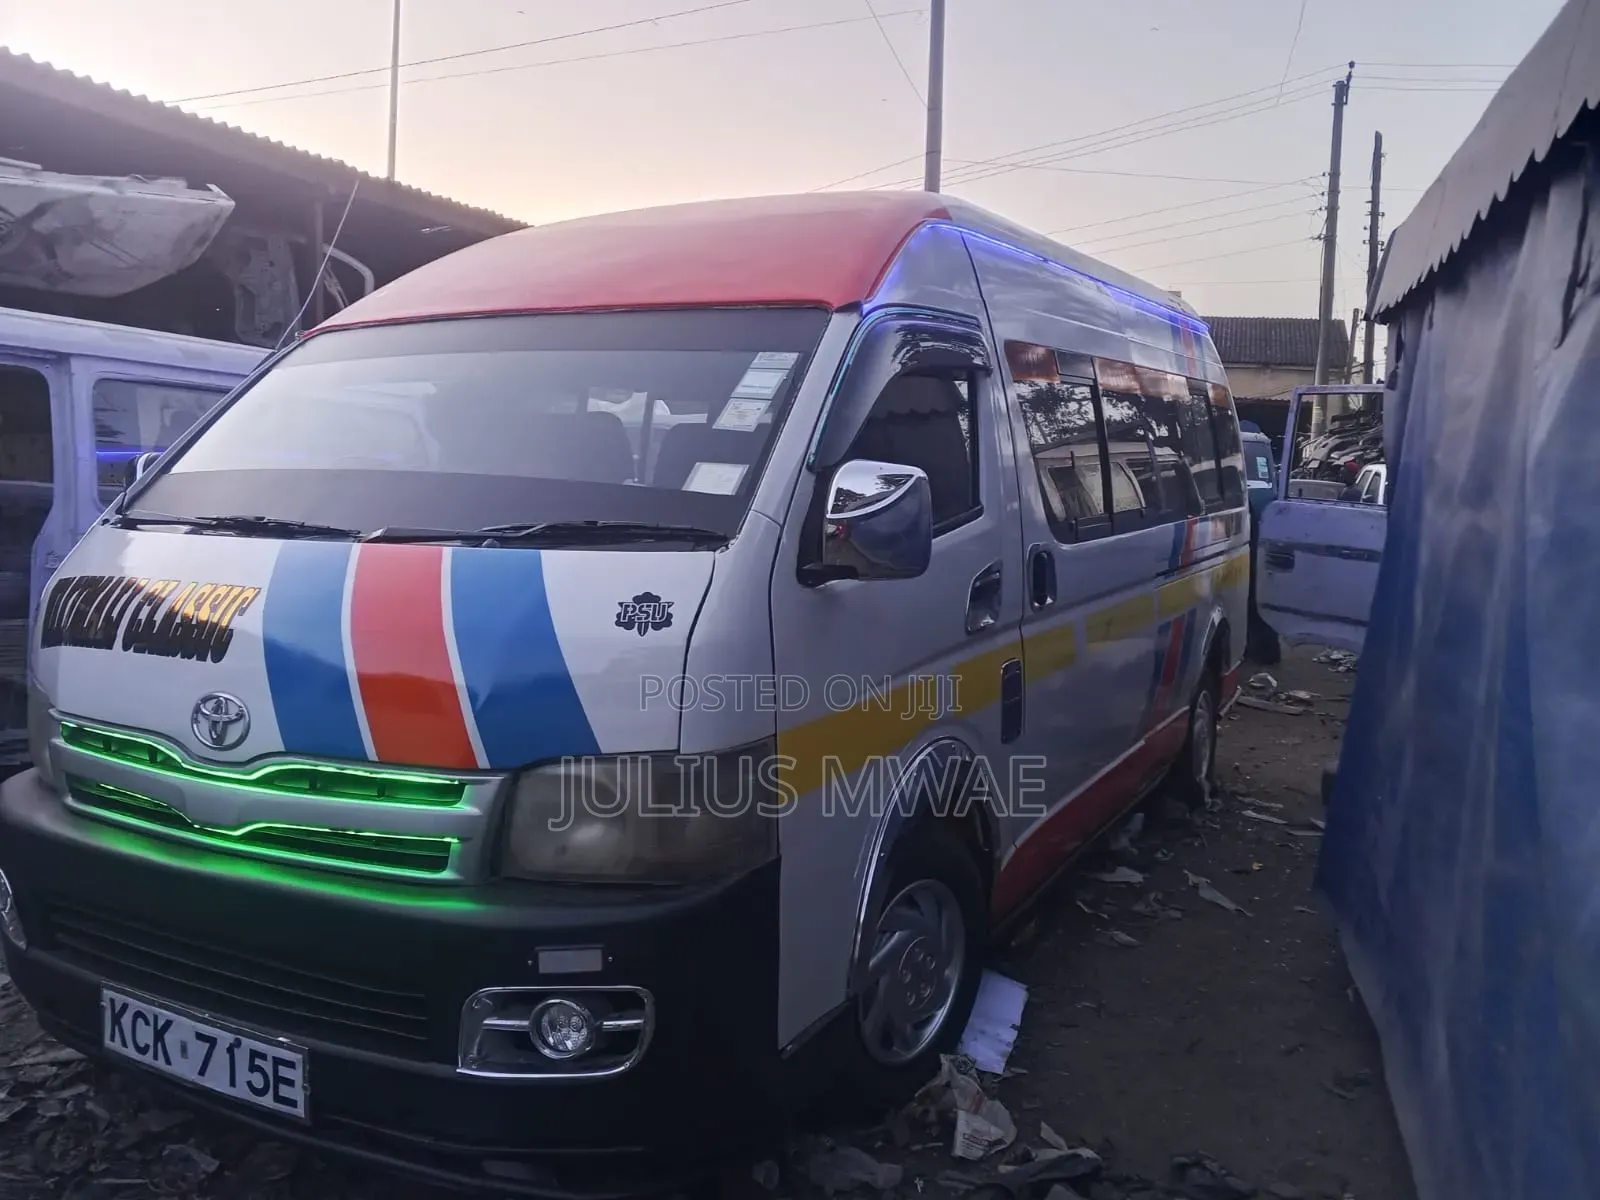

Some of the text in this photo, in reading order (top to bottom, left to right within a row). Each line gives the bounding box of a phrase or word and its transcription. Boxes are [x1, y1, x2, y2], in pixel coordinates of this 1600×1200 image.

[620, 602, 669, 623] PSU
[108, 997, 299, 1110] KCK 715E
